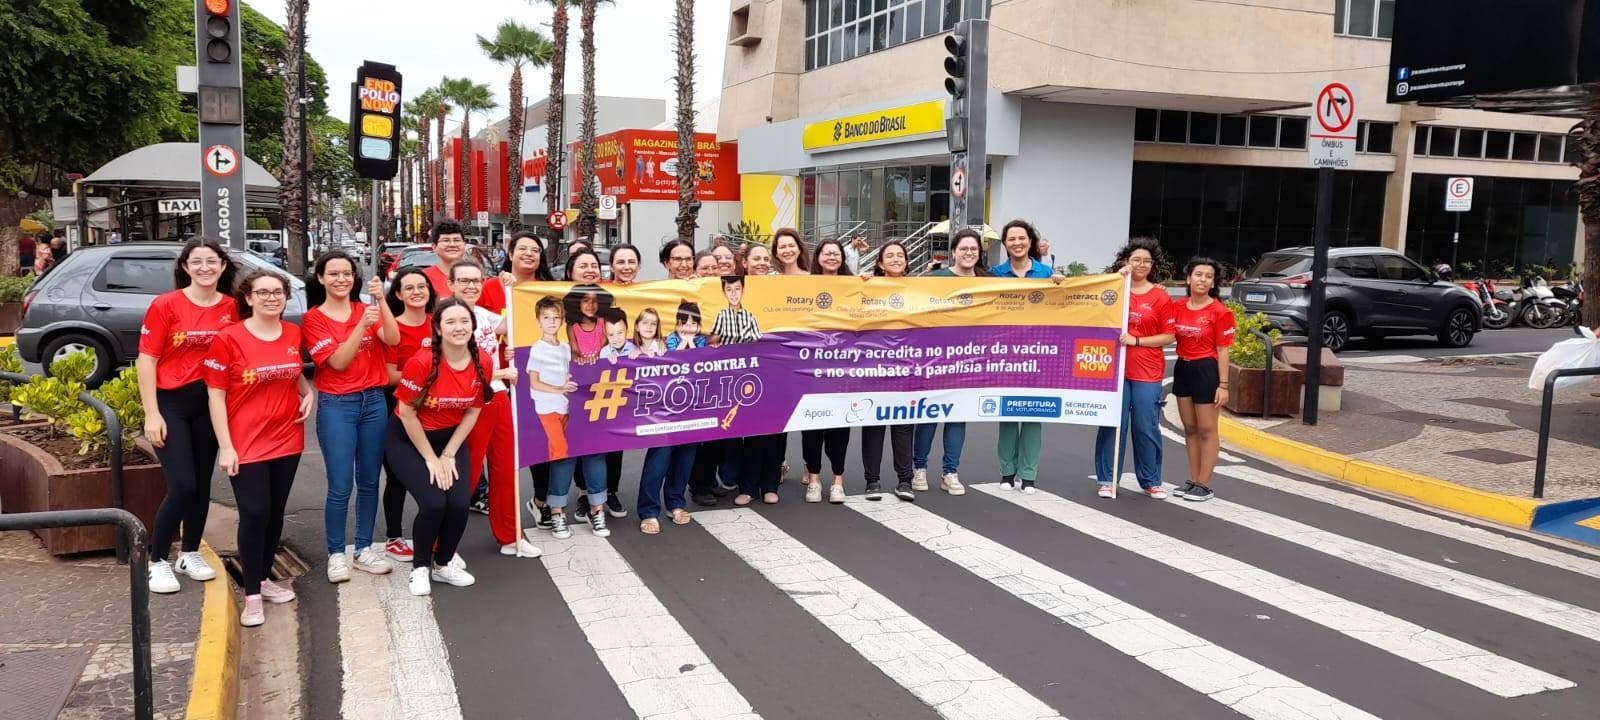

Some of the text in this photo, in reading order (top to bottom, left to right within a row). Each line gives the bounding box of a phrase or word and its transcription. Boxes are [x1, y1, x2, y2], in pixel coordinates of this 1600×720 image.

[365, 79, 395, 92] END
[359, 87, 399, 103] POLIO
[361, 98, 395, 112] NOW
[844, 115, 906, 138] BANCO DO BRASIL
[1313, 158, 1349, 167] CAMINHÕES
[1456, 183, 1464, 194] E
[160, 201, 198, 211] TAXI
[604, 198, 611, 207] E
[217, 187, 231, 247] LAGOAS
[786, 296, 814, 306] Rotary
[861, 296, 887, 306] Rotary
[800, 341, 1058, 362] O Rotary acredita no poder da vacina
[1082, 345, 1108, 355] END
[1075, 353, 1113, 364] POLIO
[635, 356, 759, 380] JUNTOS CONTRA A
[814, 359, 1041, 379] e no combate à paralisia infantil.
[1079, 361, 1109, 372] NOW
[584, 368, 633, 422] #
[634, 373, 763, 417] PÓLIO
[876, 397, 954, 421] unifev
[1007, 400, 1057, 408] PREFEITURA
[1064, 401, 1108, 410] SECRETARIA
[804, 409, 833, 420] Apoio:
[1076, 408, 1098, 416] SAÚDE
